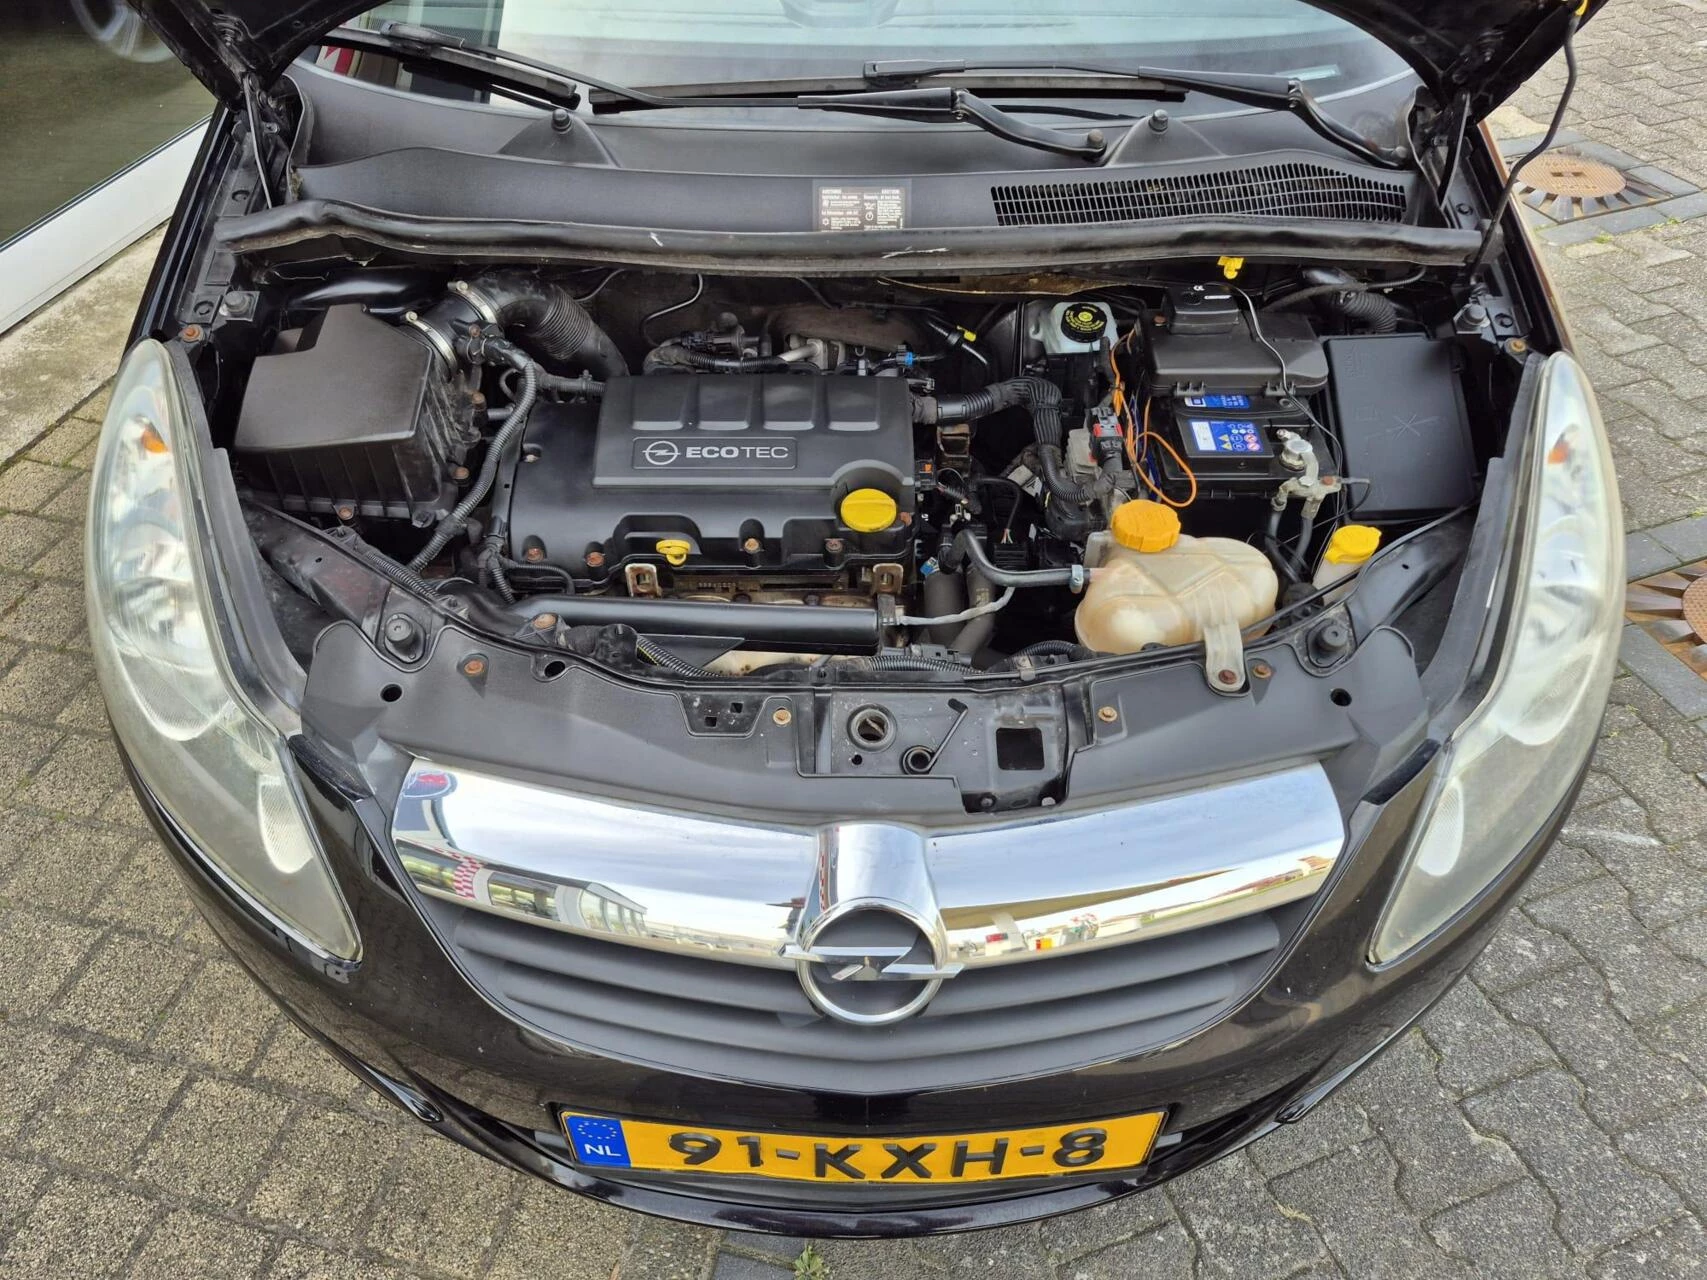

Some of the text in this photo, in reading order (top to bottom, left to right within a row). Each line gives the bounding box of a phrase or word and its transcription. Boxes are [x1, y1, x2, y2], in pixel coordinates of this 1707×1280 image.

[686, 446, 789, 458] ECOTEC
[584, 1143, 622, 1157] NL
[668, 1127, 1108, 1179] 91-KXH-8
